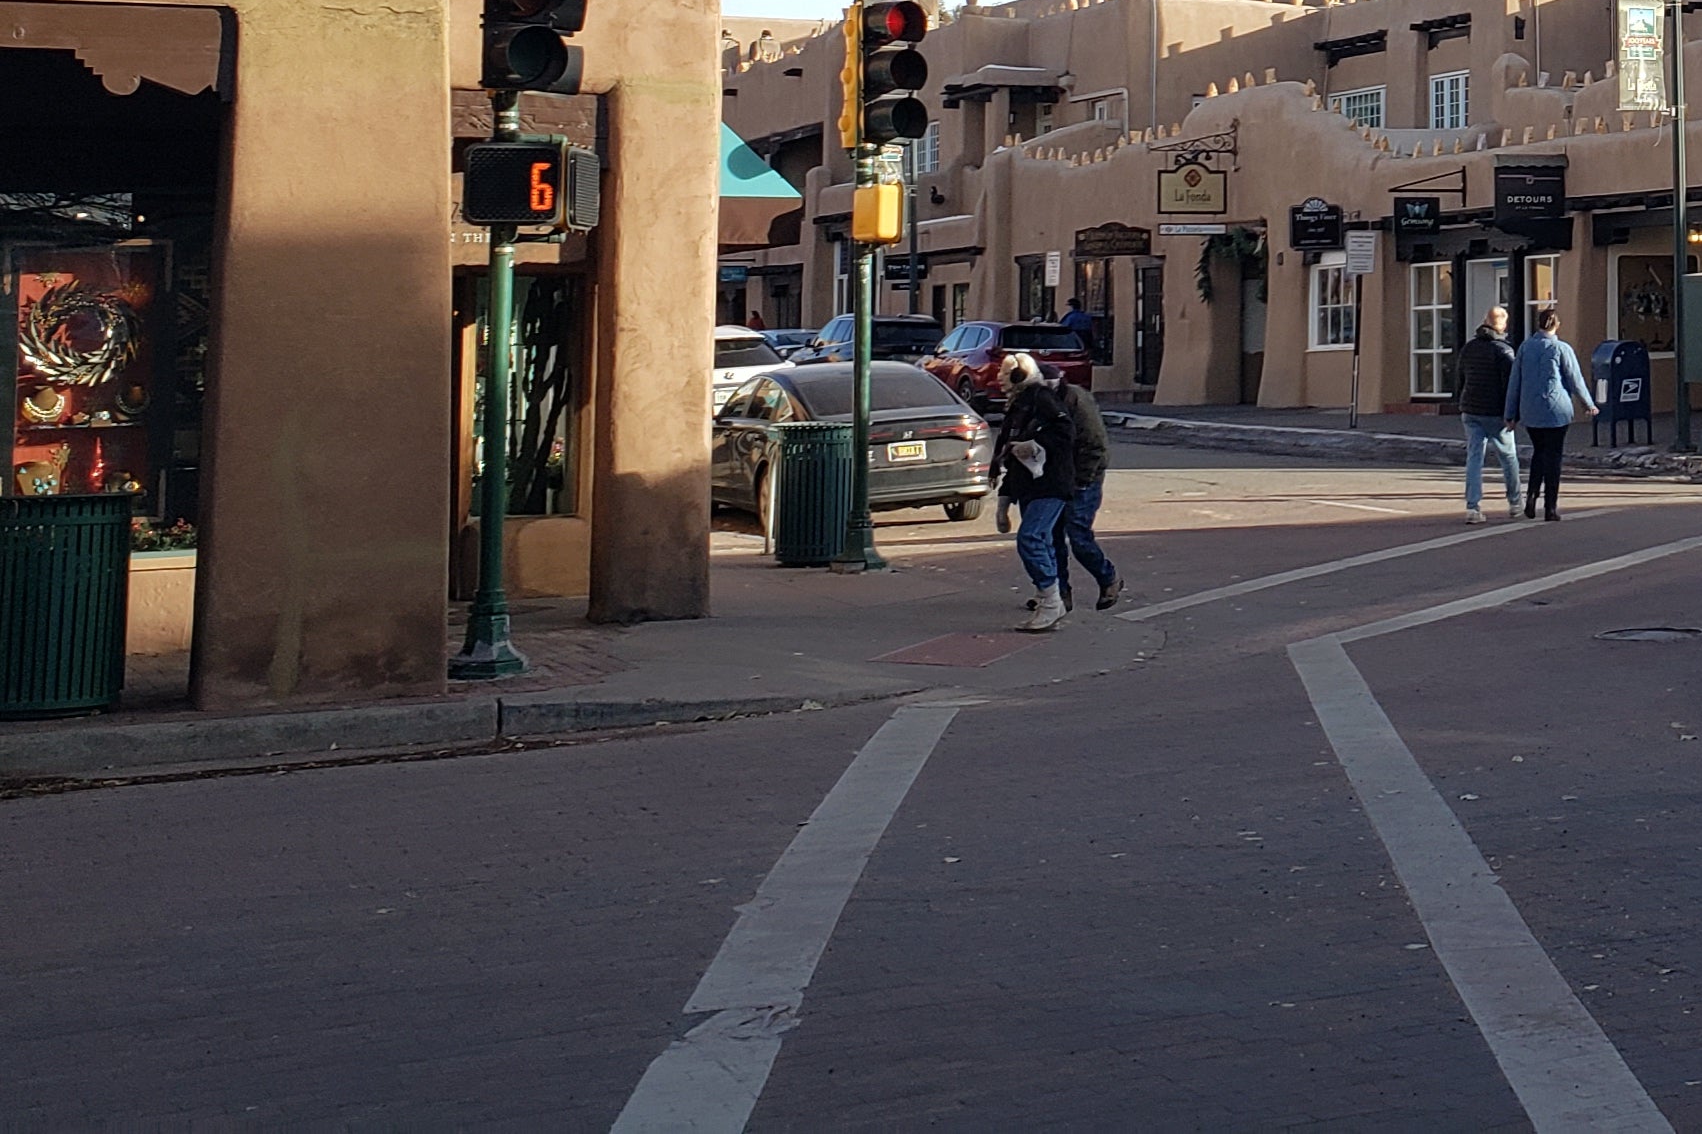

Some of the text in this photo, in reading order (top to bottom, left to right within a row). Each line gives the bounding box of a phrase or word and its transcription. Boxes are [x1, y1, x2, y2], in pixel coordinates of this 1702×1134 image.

[530, 162, 553, 211] 6
[1174, 188, 1211, 204] La Fonda
[1507, 195, 1553, 204] DETOURS
